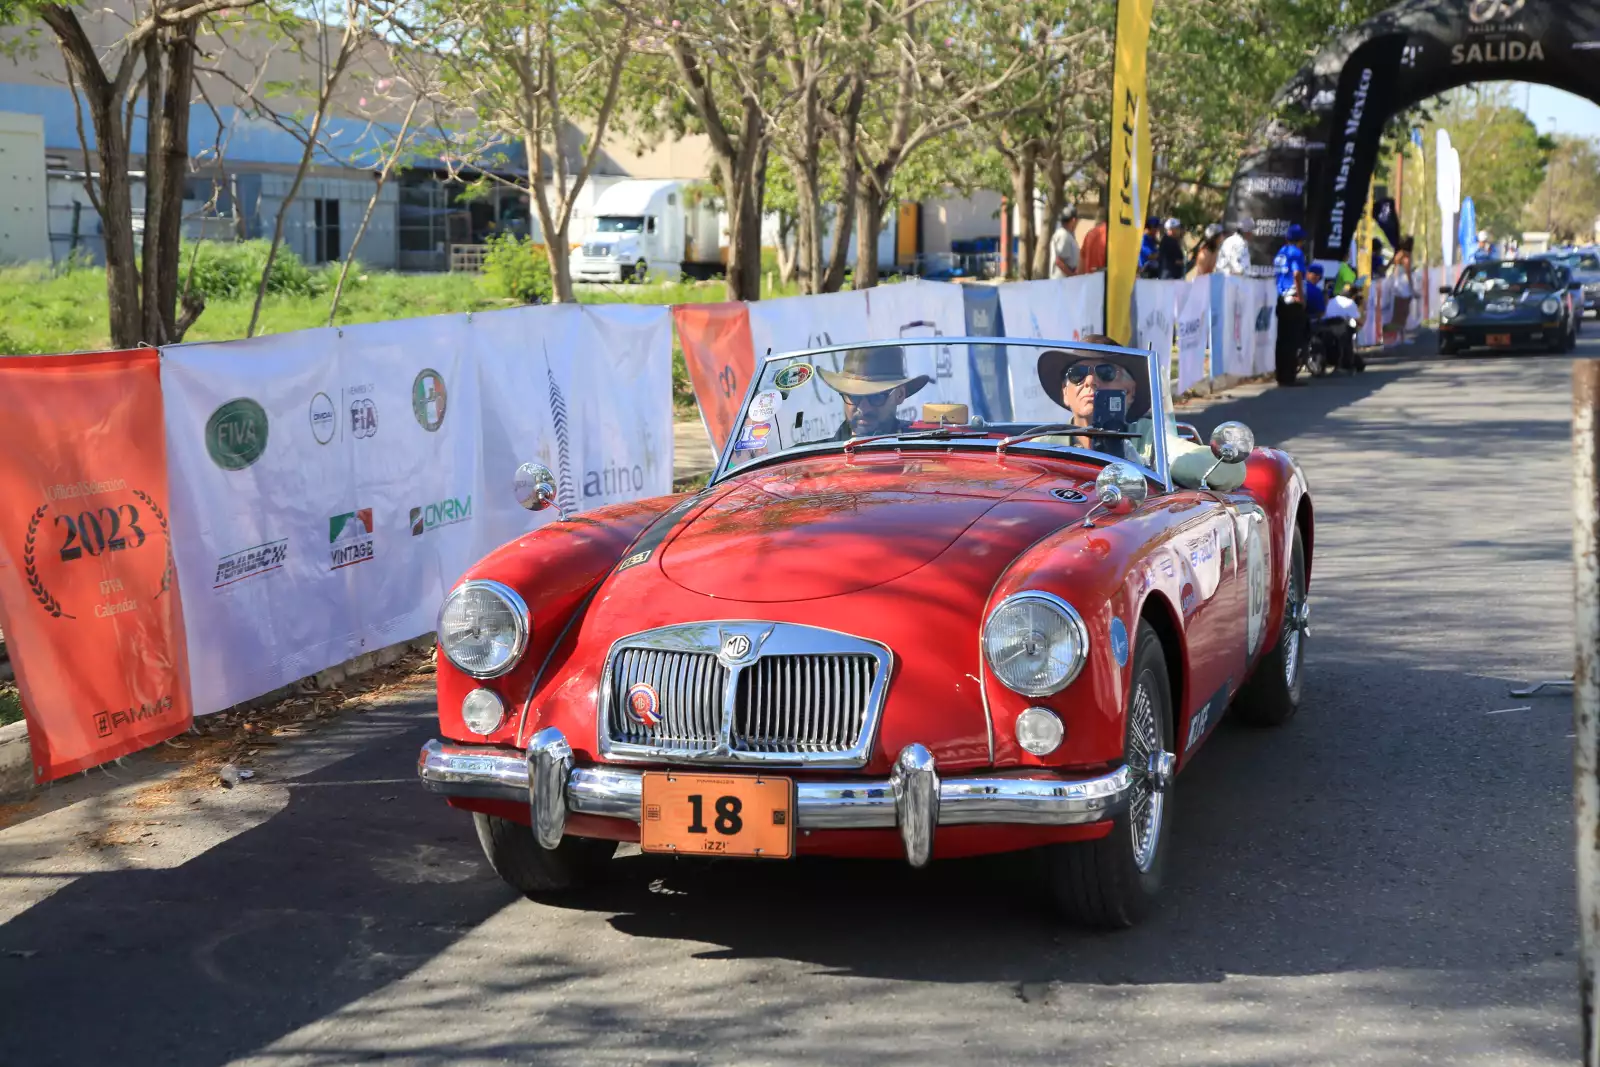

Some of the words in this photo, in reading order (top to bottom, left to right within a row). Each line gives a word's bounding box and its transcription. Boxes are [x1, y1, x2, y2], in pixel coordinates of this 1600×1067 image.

[1451, 40, 1545, 65] SALIDA
[1344, 67, 1373, 136] Mexico
[1334, 141, 1355, 192] Maya
[1327, 200, 1346, 249] Rally
[217, 419, 257, 449] FIVA
[83, 478, 128, 496] Selection
[54, 504, 146, 562] 2023
[330, 540, 374, 565] VINTAGE
[99, 578, 124, 596] FIVA
[94, 598, 139, 619] Calendar
[728, 636, 749, 655] MG
[687, 794, 743, 836] 18
